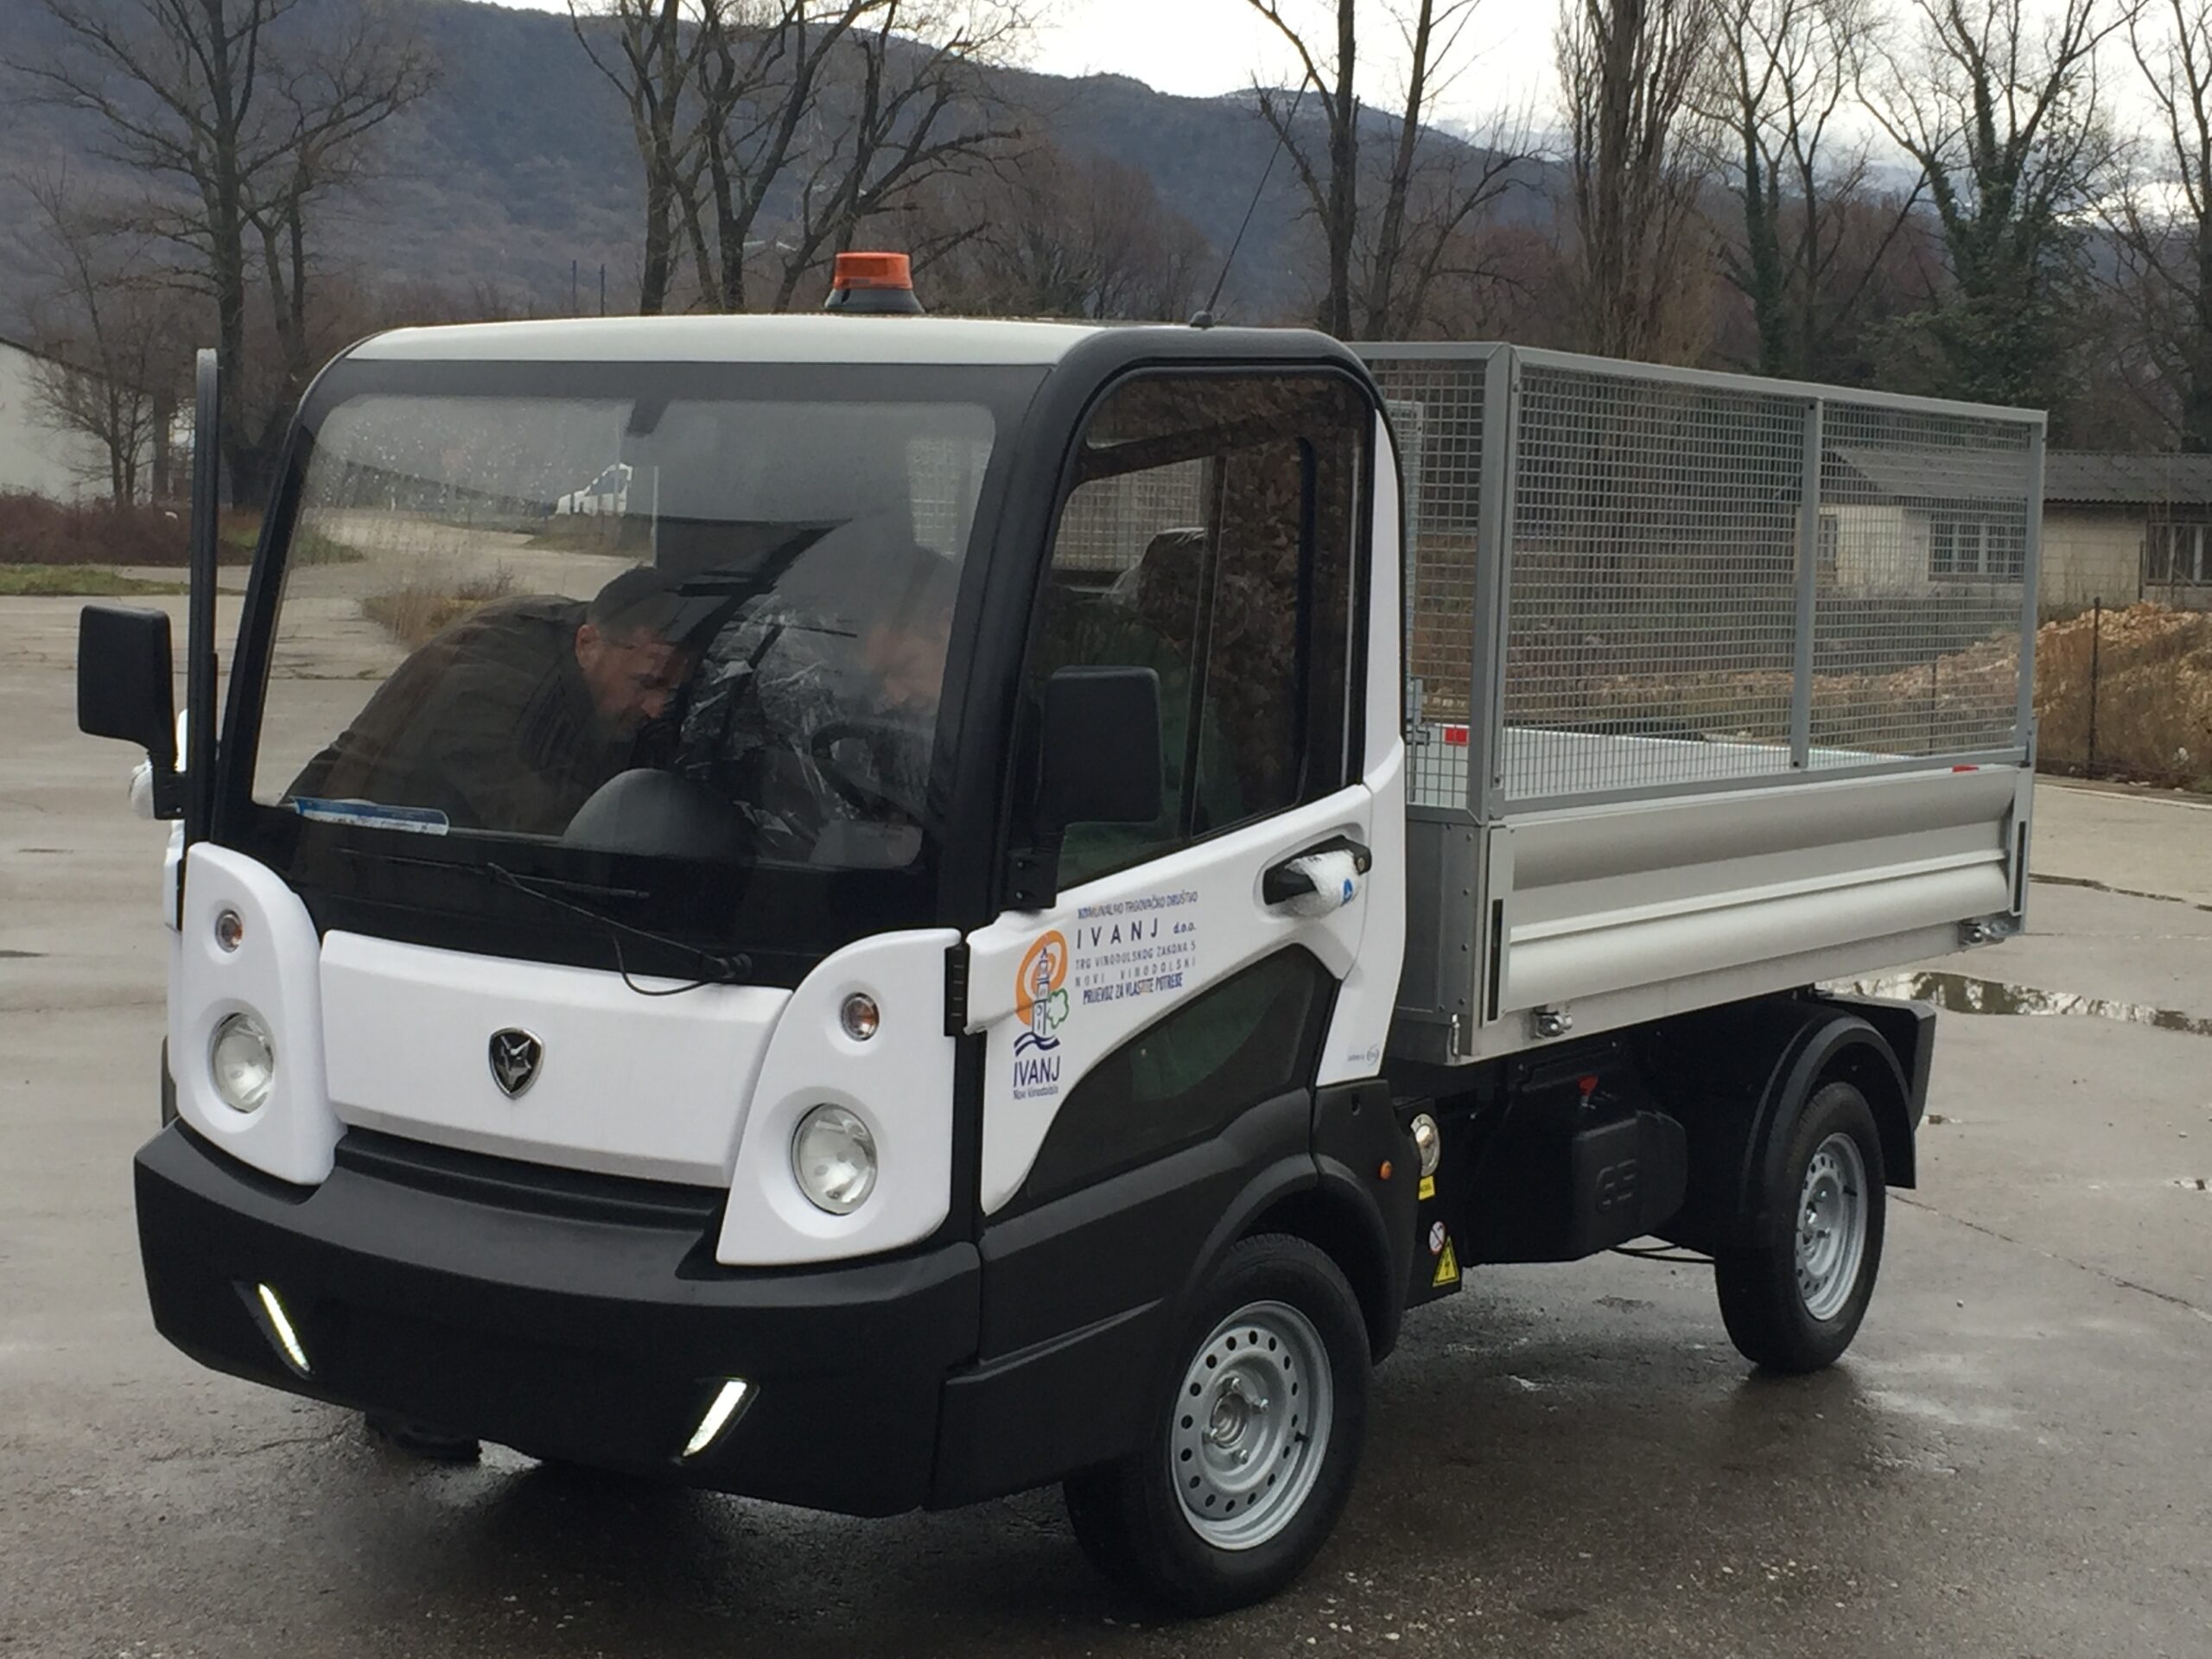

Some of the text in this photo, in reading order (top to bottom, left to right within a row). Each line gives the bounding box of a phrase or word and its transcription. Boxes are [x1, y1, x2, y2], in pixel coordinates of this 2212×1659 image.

[1077, 917, 1196, 950] IVANJ d.o.o.
[1075, 956, 1196, 987] NOVI VINODOLSKI
[1076, 957, 1091, 970] TRG
[1095, 947, 1154, 968] VINODOLSKOG
[1157, 942, 1188, 958] ZAKONA
[1116, 983, 1124, 1000] ZA
[1014, 1054, 1060, 1088] IVANJ
